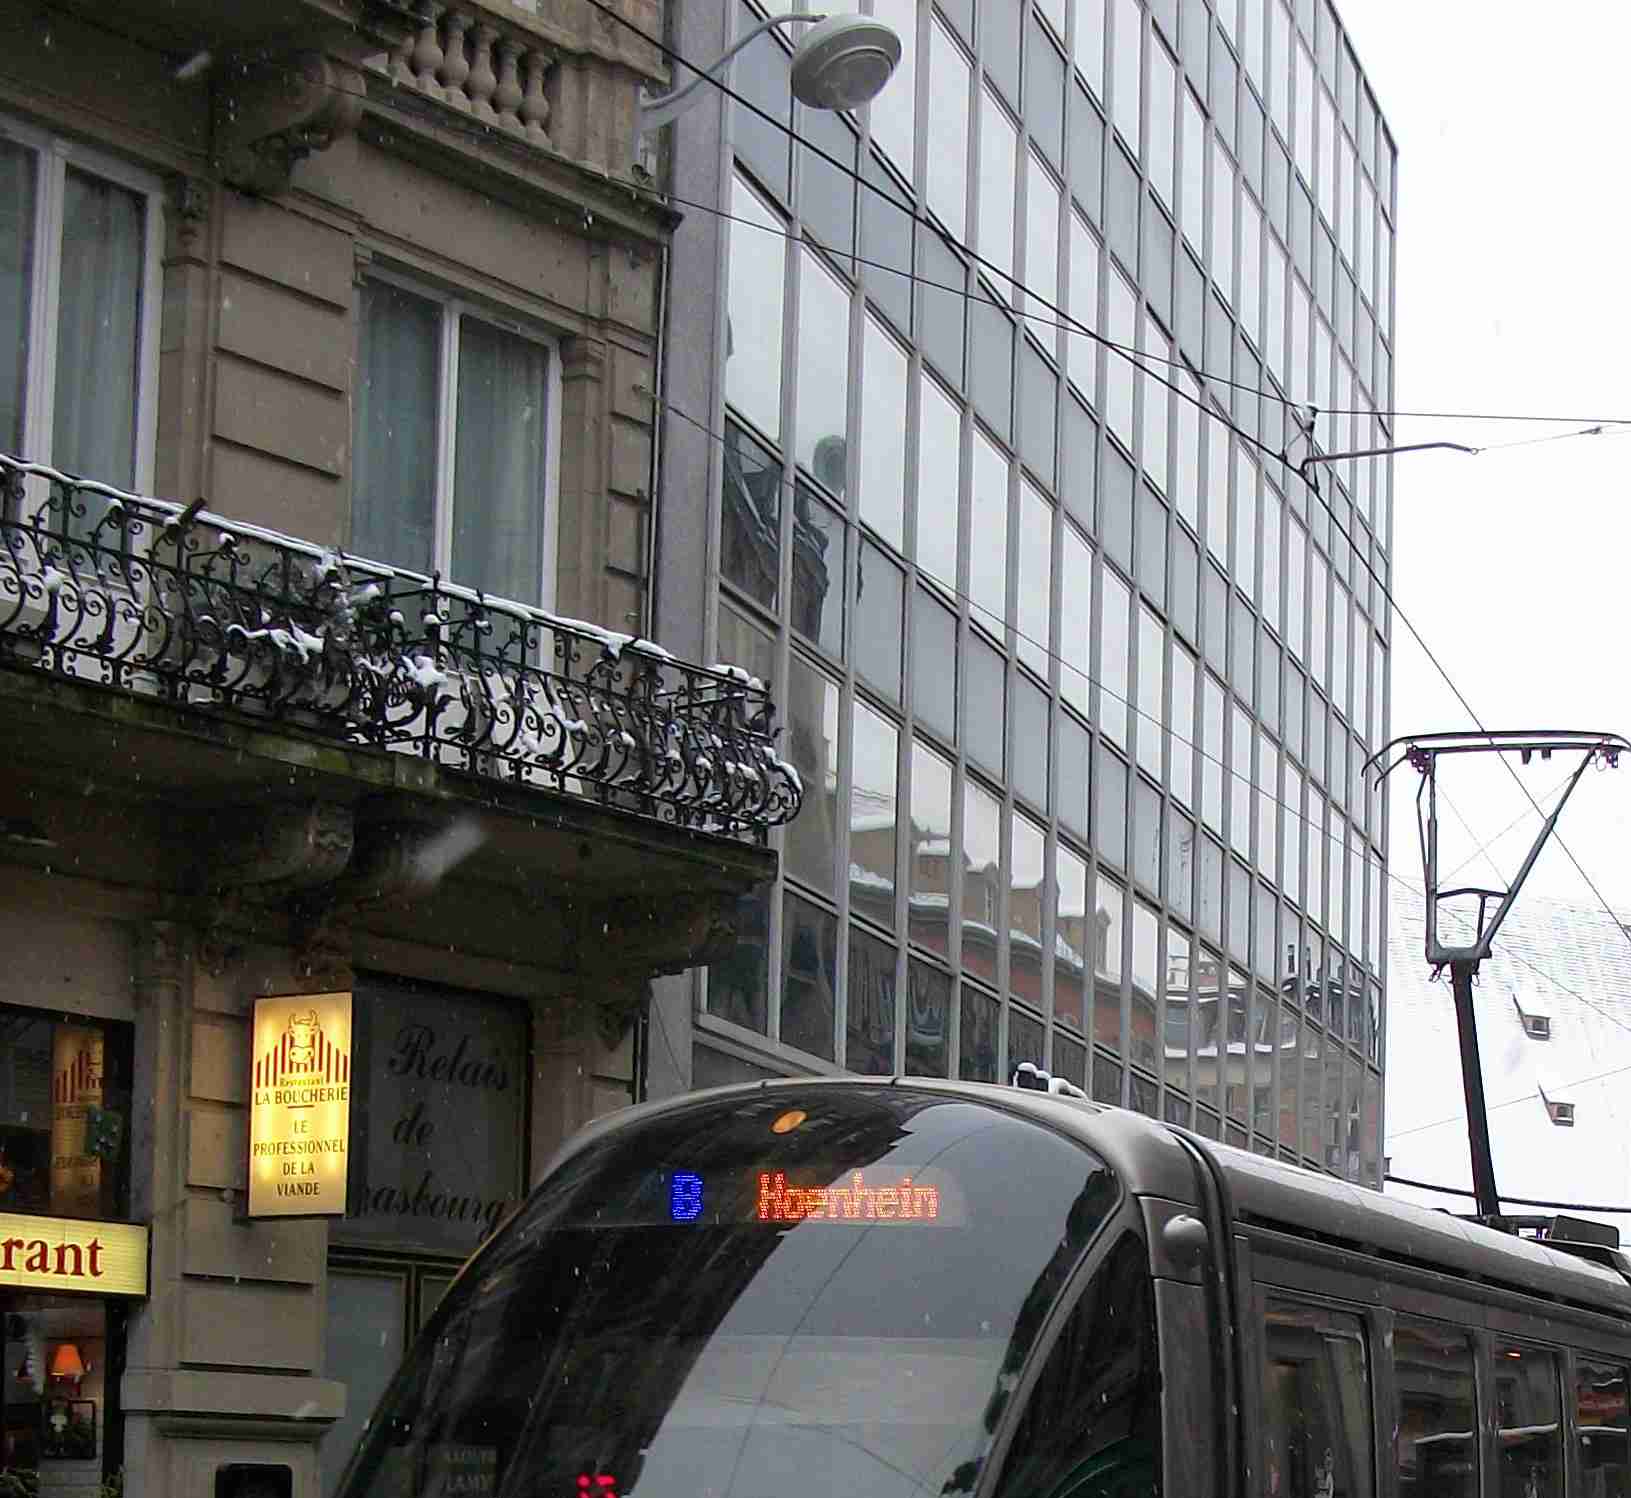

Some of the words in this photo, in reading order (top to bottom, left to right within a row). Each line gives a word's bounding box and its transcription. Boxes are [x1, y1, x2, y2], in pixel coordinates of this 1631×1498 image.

[389, 1023, 508, 1091] Relais
[255, 1091, 270, 1105] LA
[275, 1086, 348, 1104] BOUCHERIE
[294, 1120, 307, 1133] LE
[393, 1102, 434, 1146] de
[254, 1139, 345, 1156] PROFESSIONNEL
[283, 1162, 297, 1176] DE
[301, 1161, 315, 1175] LA
[277, 1182, 320, 1196] VIANDE
[671, 1174, 703, 1220] B
